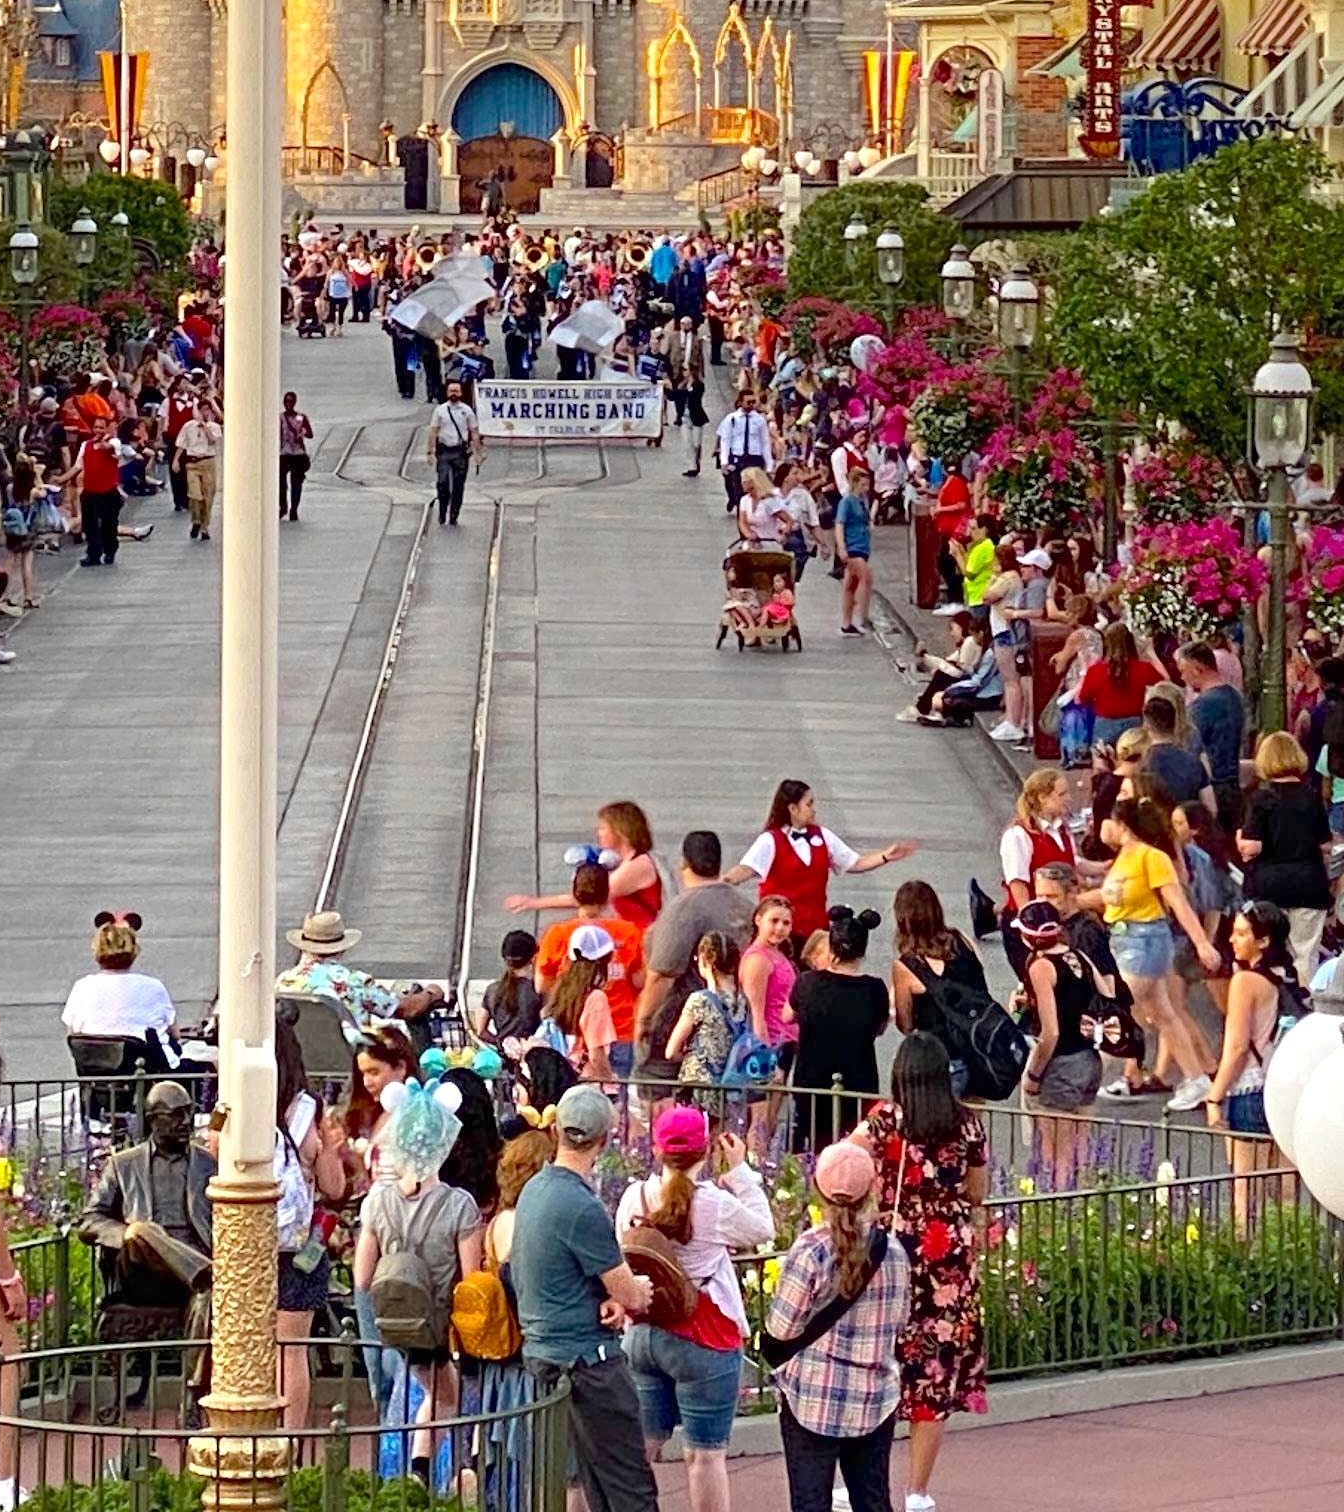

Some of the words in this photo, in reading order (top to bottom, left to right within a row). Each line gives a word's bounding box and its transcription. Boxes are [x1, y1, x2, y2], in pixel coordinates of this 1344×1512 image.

[1094, 82, 1114, 133] ARTS
[479, 387, 527, 399] FRANCIS
[532, 388, 579, 399] HOWELL
[584, 388, 612, 399] HIGH
[491, 402, 590, 419] MARCHING
[595, 403, 645, 419] BAND
